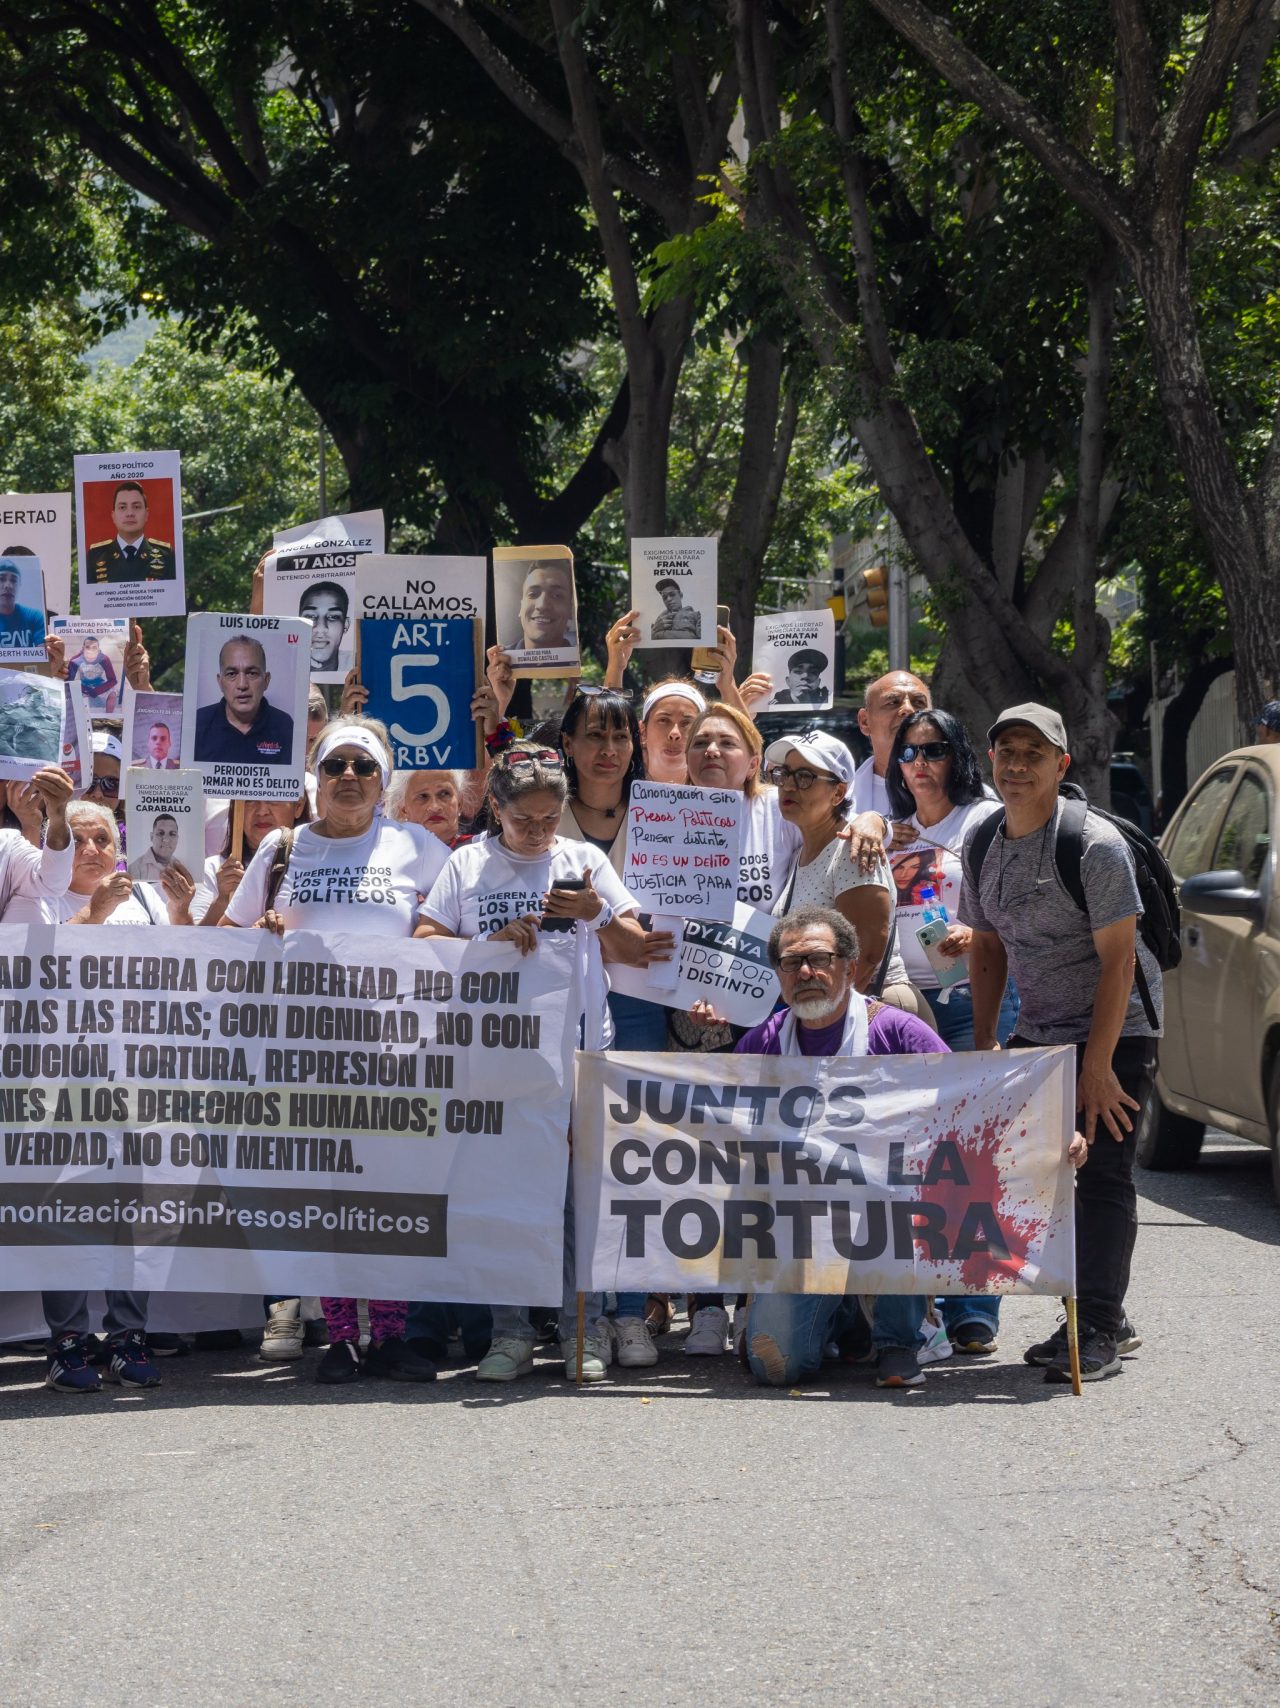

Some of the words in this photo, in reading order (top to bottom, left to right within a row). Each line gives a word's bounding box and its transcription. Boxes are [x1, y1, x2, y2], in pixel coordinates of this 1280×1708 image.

[98, 463, 121, 471] PRESO
[122, 461, 154, 469] POLÍTICO
[314, 537, 372, 549] GONZÁLEZ
[293, 558, 308, 569] 17
[312, 554, 355, 568] AÑOS
[277, 573, 310, 581] DETENIDO
[653, 568, 693, 576] REVILLA
[406, 579, 436, 595] NO
[362, 595, 478, 616] CALLAMOS,
[220, 616, 244, 629] LUIS
[246, 617, 280, 630] LOPEZ
[287, 634, 299, 643] LV
[392, 622, 450, 649] ART.
[768, 633, 818, 641] JHONATAN
[23, 649, 44, 657] RIVAS
[390, 653, 451, 747] 5
[214, 765, 270, 777] PERIODISTA
[236, 777, 250, 787] NO
[253, 778, 263, 788] ES
[266, 779, 299, 789] DELITO
[141, 796, 184, 804] JOHNDRY
[136, 804, 191, 813] CARABALLO
[631, 853, 648, 866] NO
[652, 854, 668, 866] ES
[673, 855, 689, 867] UN
[294, 866, 341, 880] LIBEREN
[343, 866, 351, 876] A
[353, 866, 392, 877] TODOS
[292, 878, 321, 888] LOS
[327, 876, 393, 888] PRESOS
[693, 873, 732, 890] PARA
[289, 887, 397, 907] POLÍTICOS
[478, 892, 527, 903] LIBEREN
[479, 900, 509, 918] LOS
[714, 931, 761, 958] LAYA
[39, 955, 72, 990] SE
[79, 955, 197, 992] CELEBRA
[206, 958, 266, 994] CON
[272, 961, 405, 1004] LIBERTAD,
[414, 968, 453, 1002] NO
[460, 971, 520, 1005] CON
[728, 959, 773, 985] POR
[687, 968, 765, 999] DISTINTO
[66, 999, 114, 1034] LAS
[122, 999, 211, 1040] REJAS;
[219, 1002, 278, 1038] CON
[285, 1005, 427, 1049] DIGNIDAD,
[436, 1011, 473, 1047] NO
[481, 1013, 541, 1049] CON
[124, 1043, 257, 1086] TORTURA,
[265, 1044, 417, 1088] REPRESIÓN
[424, 1054, 454, 1089] NI
[610, 1079, 866, 1128] JUNTOS
[54, 1088, 73, 1122] A
[81, 1087, 129, 1123] LOS
[137, 1089, 281, 1127] DERECHOS
[288, 1093, 438, 1137] HUMANOS;
[445, 1099, 504, 1135] CON
[4, 1132, 114, 1170] VERDAD,
[122, 1132, 162, 1167] NO
[170, 1132, 228, 1169] CON
[235, 1135, 364, 1174] MENTIRA.
[610, 1138, 867, 1186] CONTRA
[888, 1140, 970, 1186] LA
[610, 1198, 1012, 1261] TORTURA
